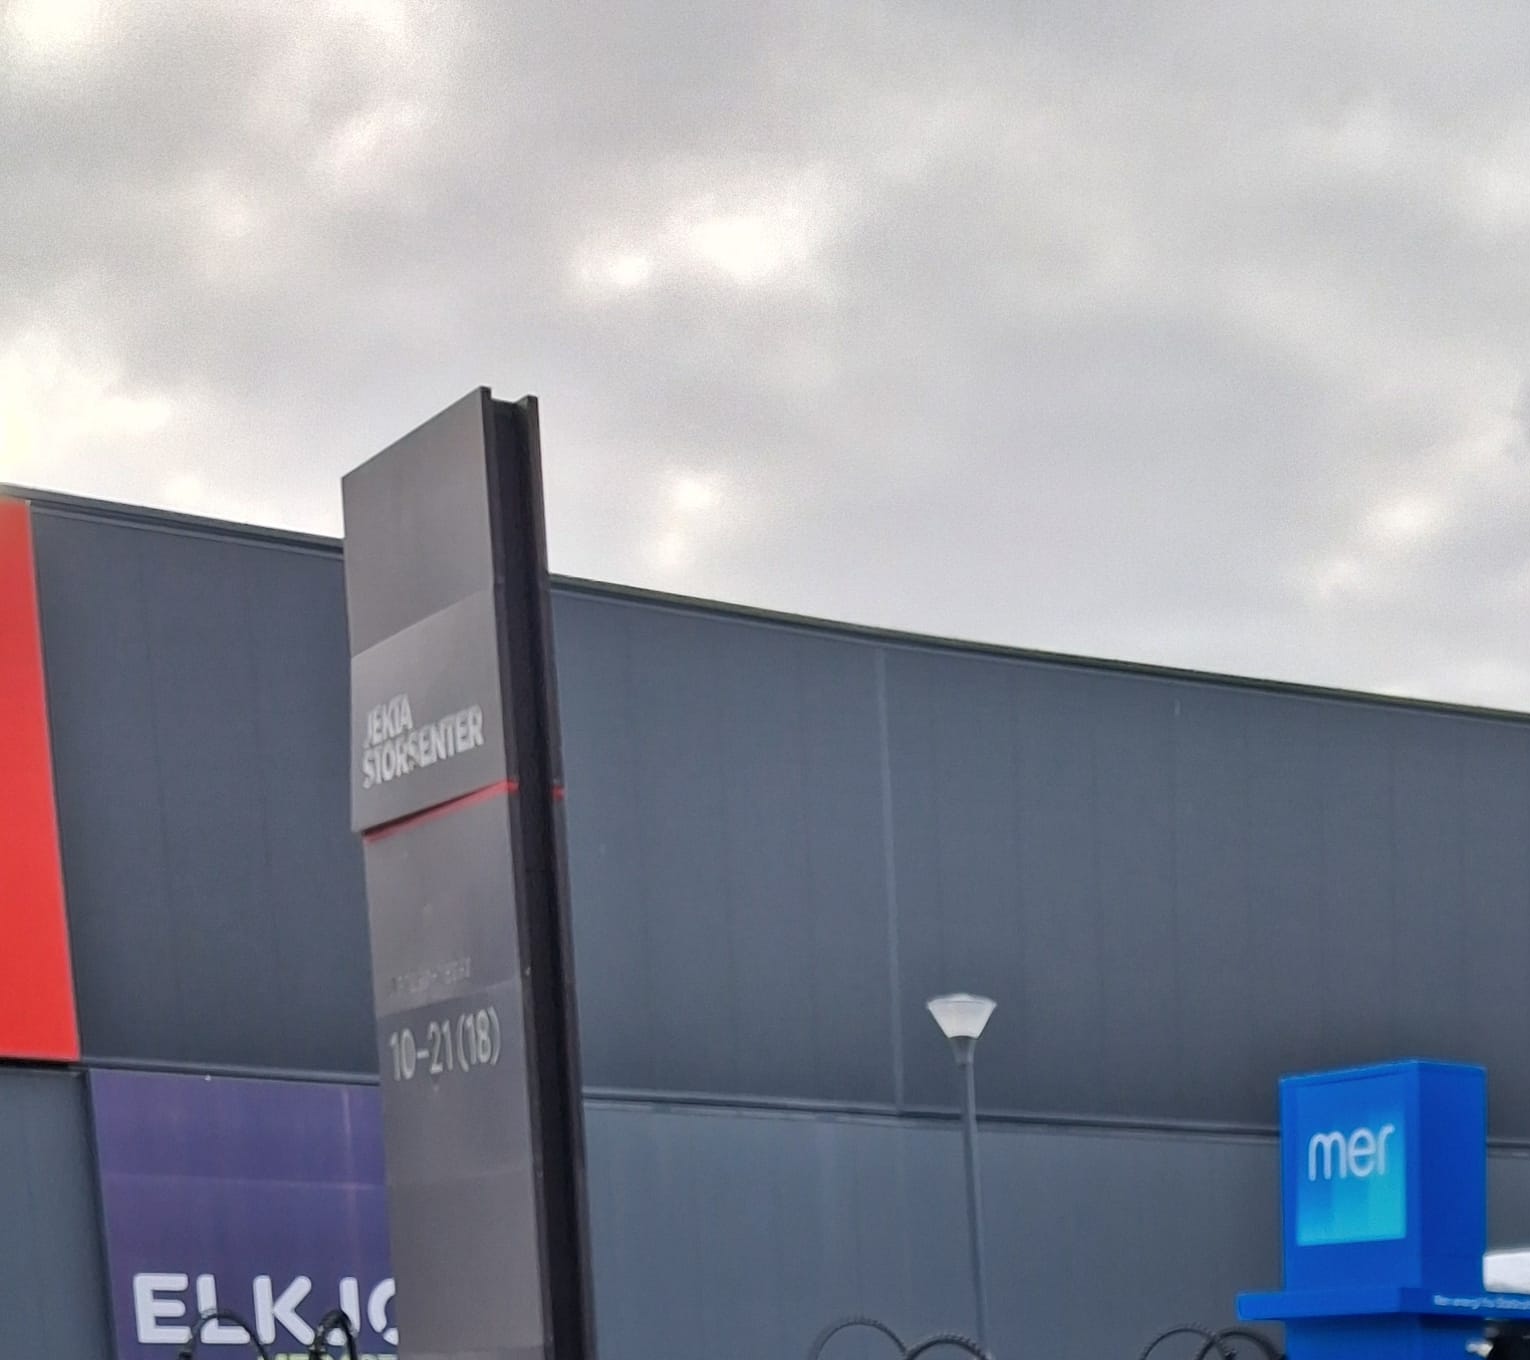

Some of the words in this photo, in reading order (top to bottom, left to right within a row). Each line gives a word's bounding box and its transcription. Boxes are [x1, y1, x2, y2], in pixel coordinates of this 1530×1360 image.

[361, 703, 485, 790] STORSENTER
[364, 693, 414, 748] JEKTA
[1307, 1122, 1396, 1183] mer
